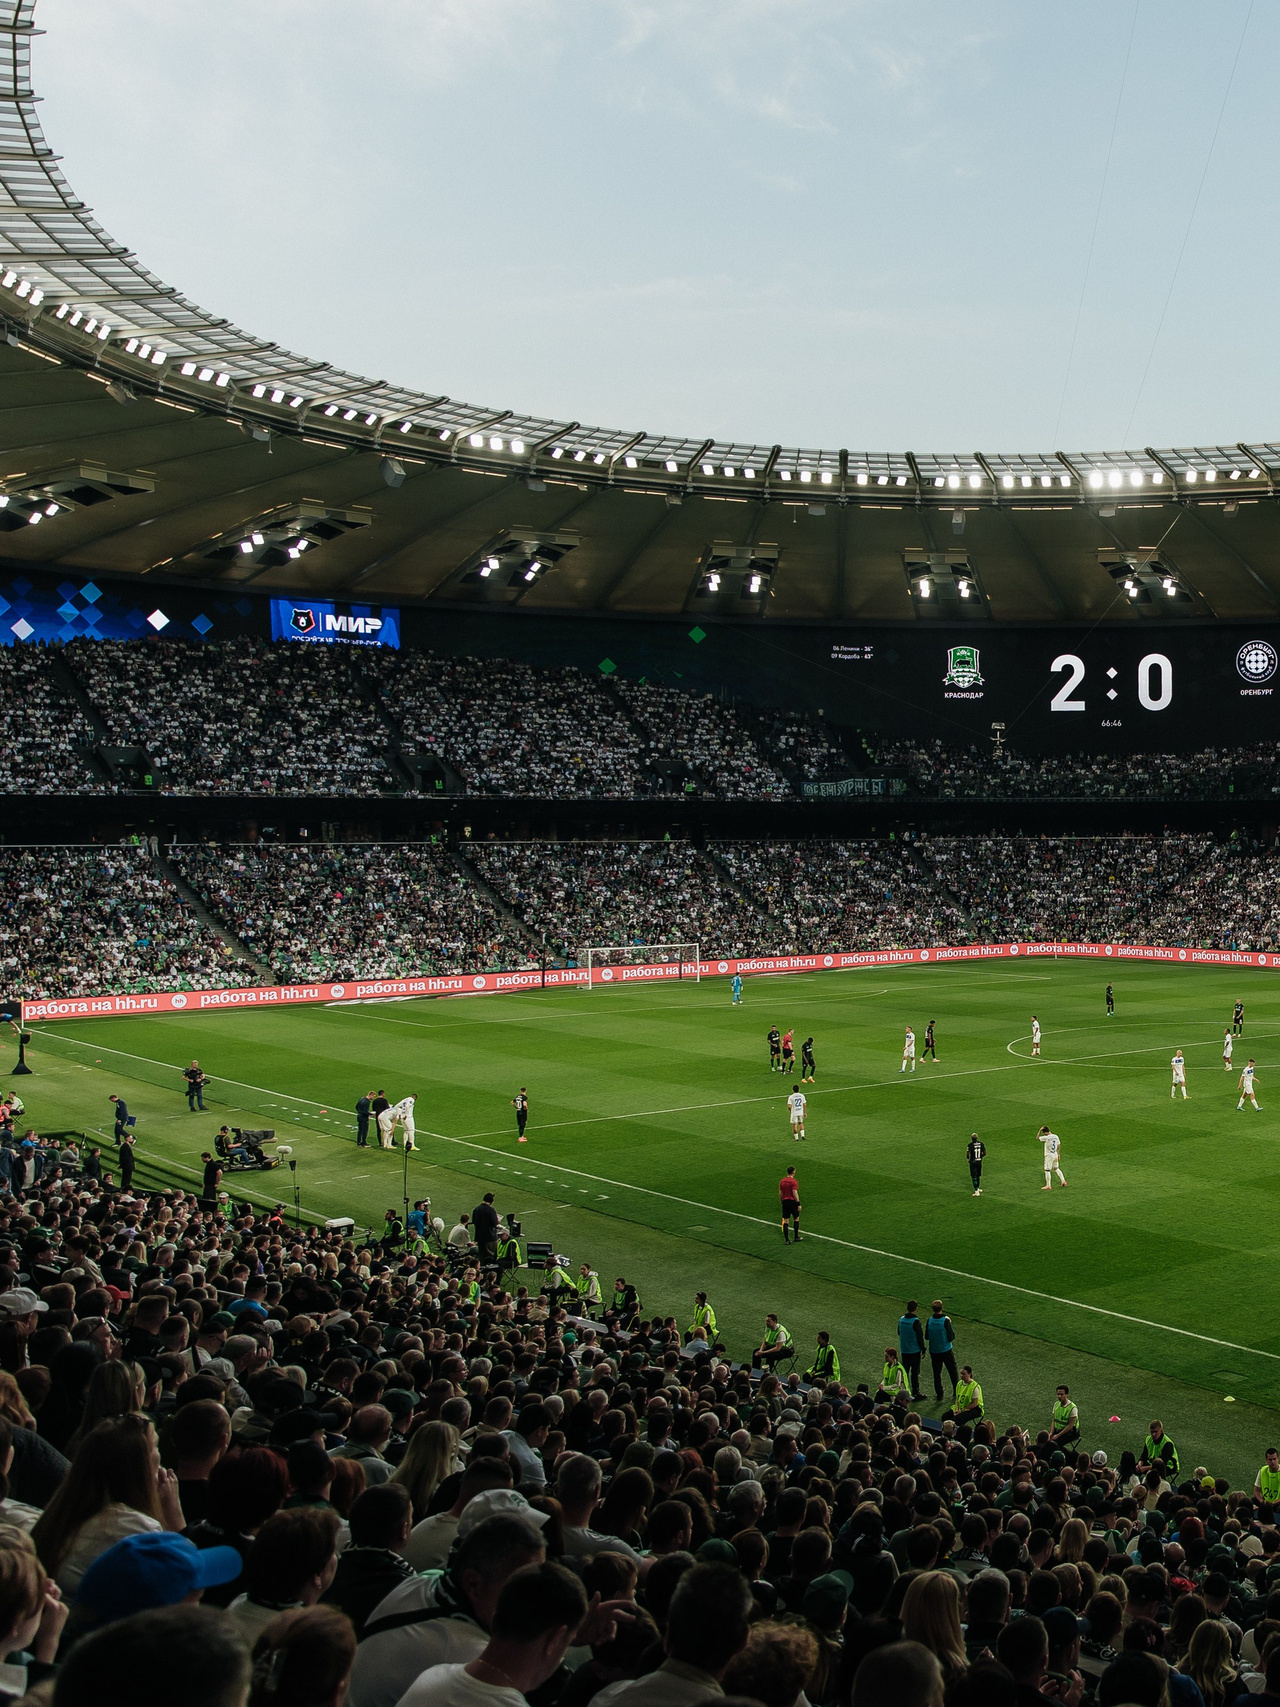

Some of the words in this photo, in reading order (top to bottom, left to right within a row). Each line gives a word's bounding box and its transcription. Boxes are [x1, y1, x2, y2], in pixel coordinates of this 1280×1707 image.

[325, 614, 383, 634] МИР
[1240, 643, 1275, 659] ОРЕНБУРГ
[1050, 654, 1086, 712] 2
[1137, 653, 1173, 711] 0
[944, 692, 984, 700] КРАСНОДАР
[1240, 688, 1274, 696] ОРЕНБУРГ
[1101, 719, 1122, 727] 66:46
[937, 948, 967, 960] работа
[981, 945, 1002, 954] hh.ru
[1027, 944, 1062, 954] работа
[1078, 944, 1098, 953] hh.ru
[1118, 946, 1143, 956] работа
[1155, 948, 1173, 957] hh.ru
[841, 954, 875, 966] работа
[877, 953, 888, 961] на
[890, 951, 913, 960] hh.ru
[1193, 951, 1219, 961] работа
[1221, 953, 1230, 961] на
[1232, 953, 1251, 962] hh.ru
[737, 960, 774, 972] работа
[776, 959, 788, 967] на
[791, 958, 815, 967] hh.ru
[623, 967, 663, 980] работа
[666, 966, 679, 975] на
[497, 974, 541, 988] работа
[545, 973, 559, 982] на
[357, 982, 407, 997] работа
[410, 982, 426, 991] на
[429, 979, 462, 989] hh.ru
[201, 992, 256, 1007] работа
[260, 991, 278, 1000] на
[281, 986, 318, 999] hh.ru
[25, 1002, 88, 1019] работа
[92, 1001, 112, 1011] на
[116, 997, 158, 1010] hh.ru
[794, 1098, 802, 1107] 22
[974, 1148, 981, 1159] 11
[1263, 1486, 1279, 1500] 247
